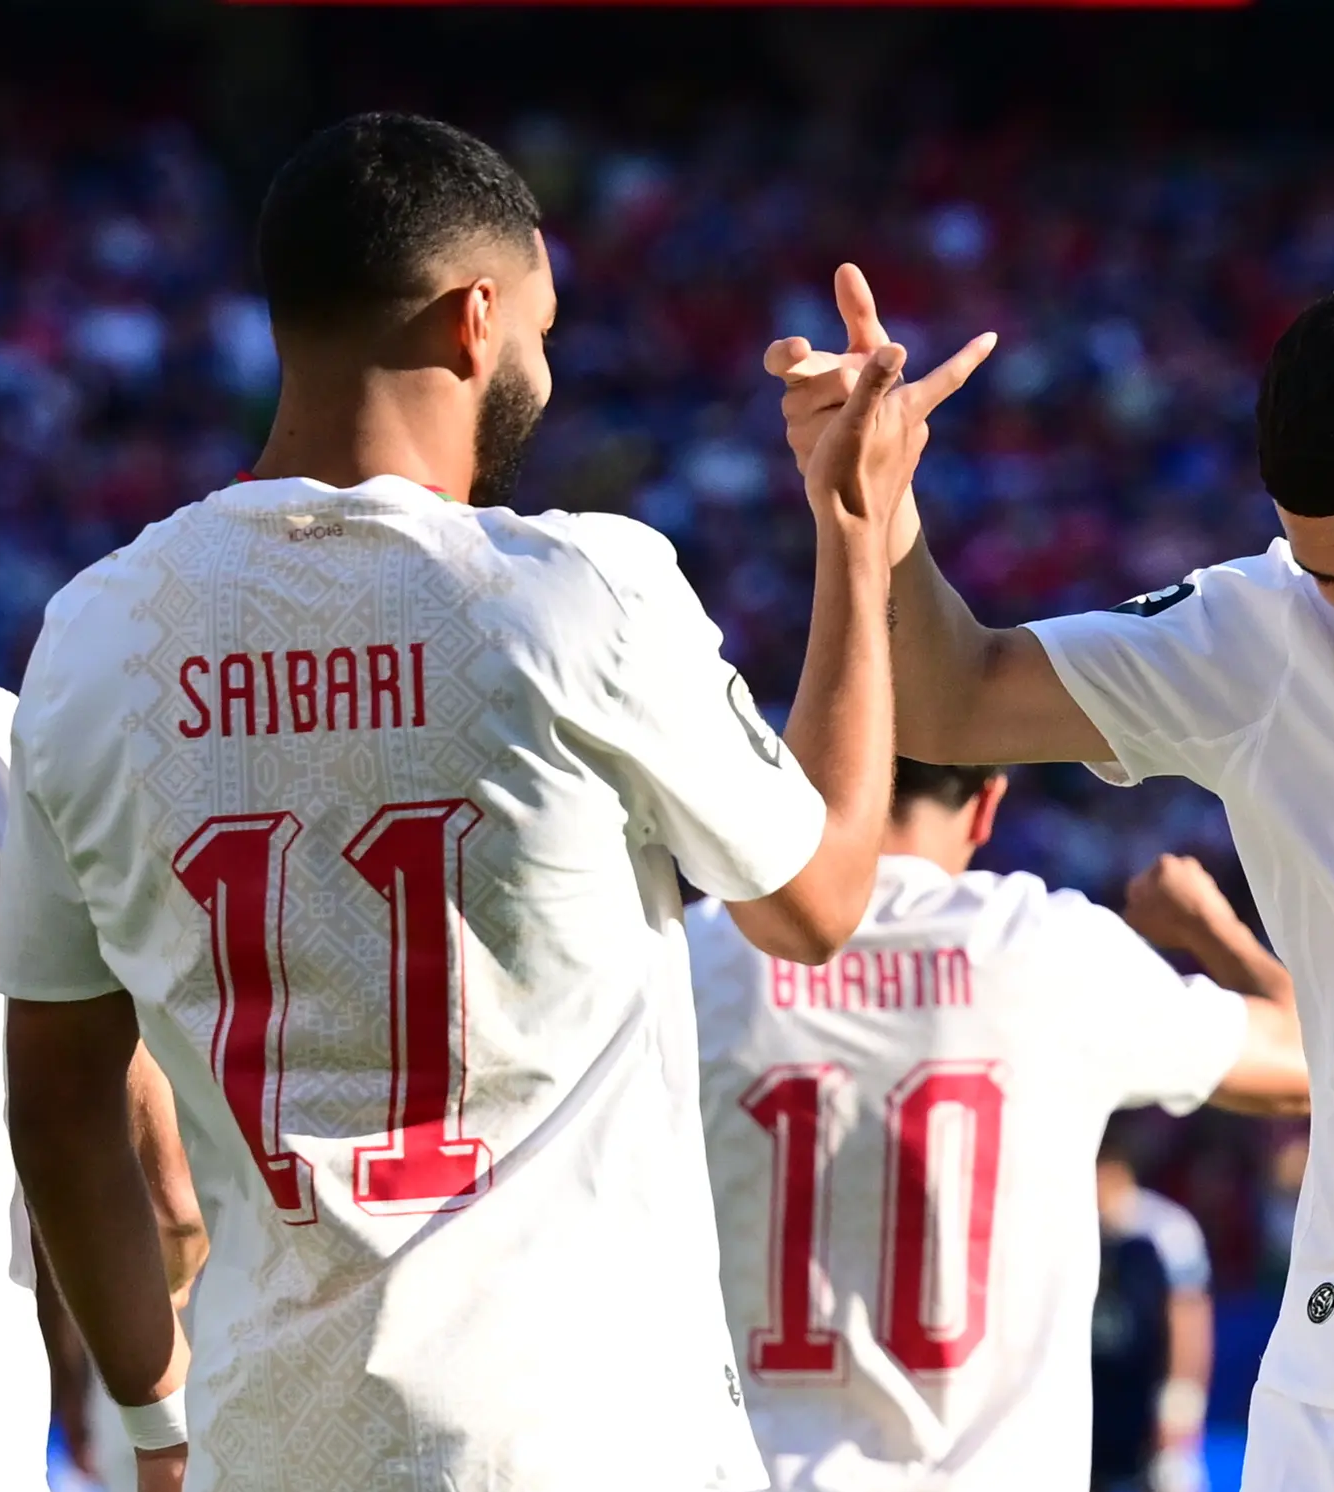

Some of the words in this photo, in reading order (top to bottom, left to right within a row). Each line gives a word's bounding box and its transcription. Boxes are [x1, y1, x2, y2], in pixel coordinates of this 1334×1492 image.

[178, 642, 427, 739] SAIBARI
[172, 797, 493, 1226] 11
[771, 947, 972, 1010] BRAHIM
[738, 1057, 1013, 1386] 10
